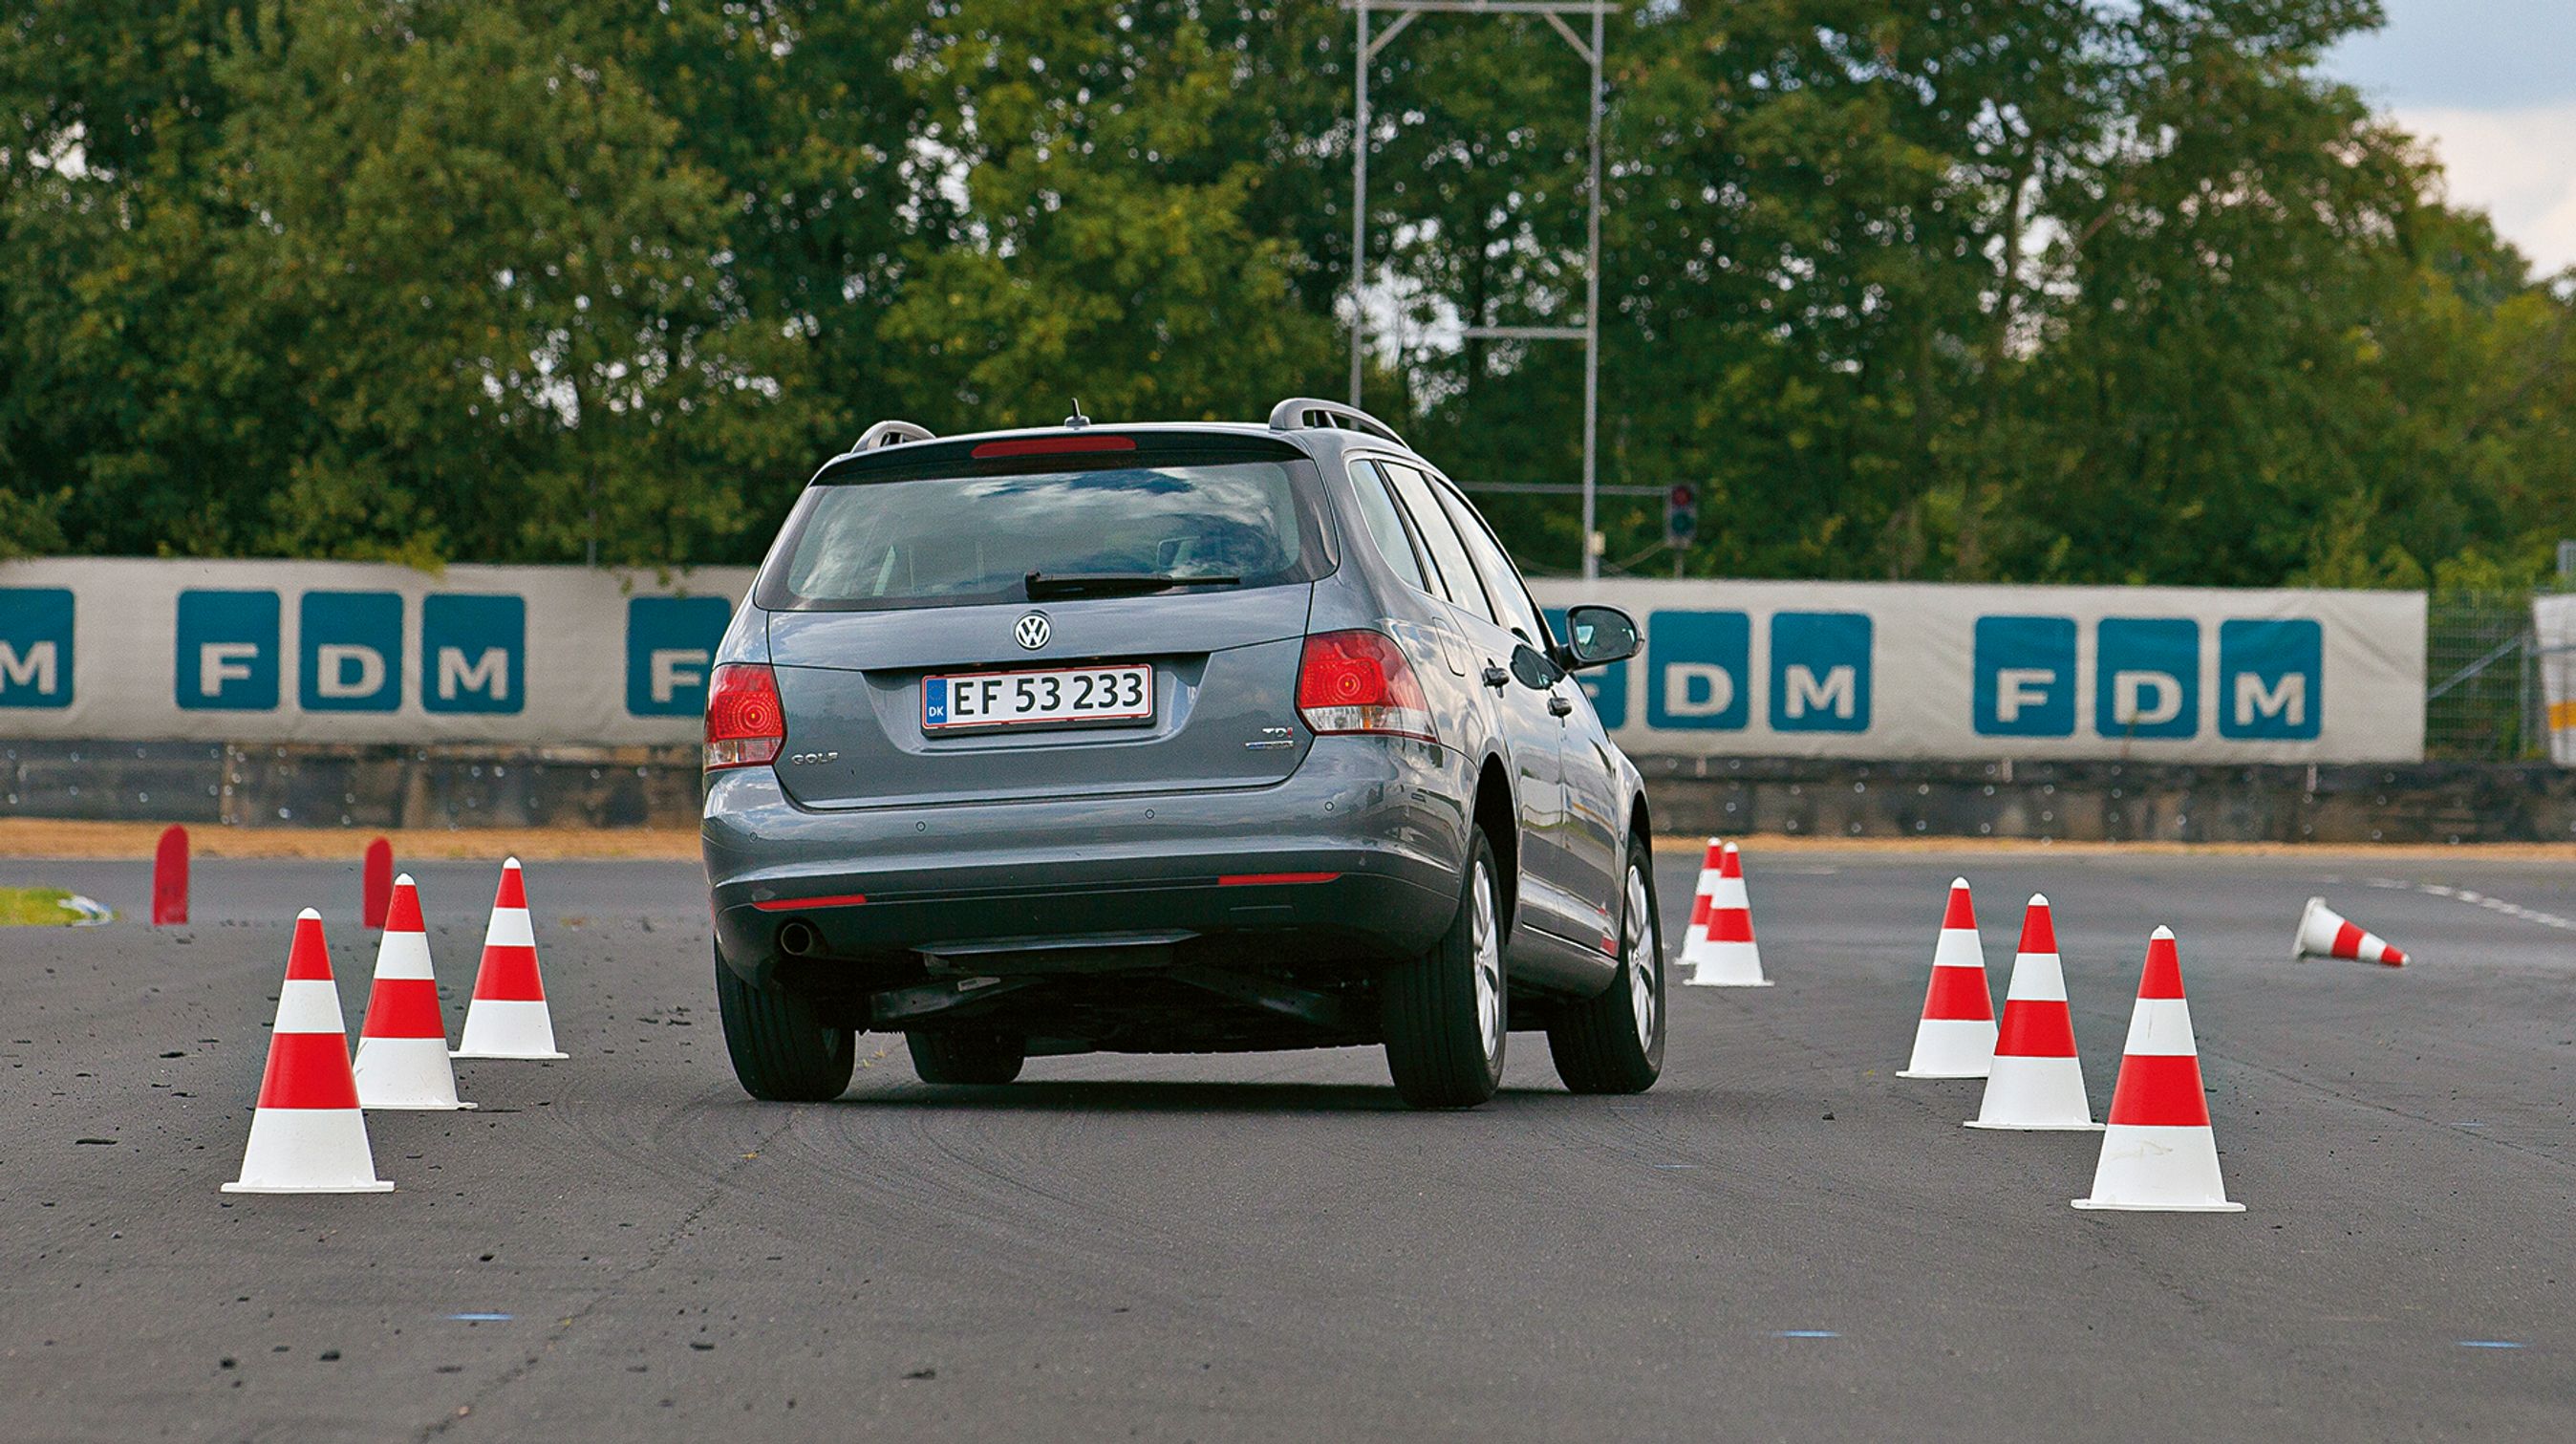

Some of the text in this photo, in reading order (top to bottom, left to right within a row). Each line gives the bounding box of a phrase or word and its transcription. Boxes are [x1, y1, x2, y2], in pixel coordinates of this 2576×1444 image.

[954, 673, 1143, 716] EF 53 233
[929, 705, 944, 717] DK
[791, 751, 839, 765] GOLF
